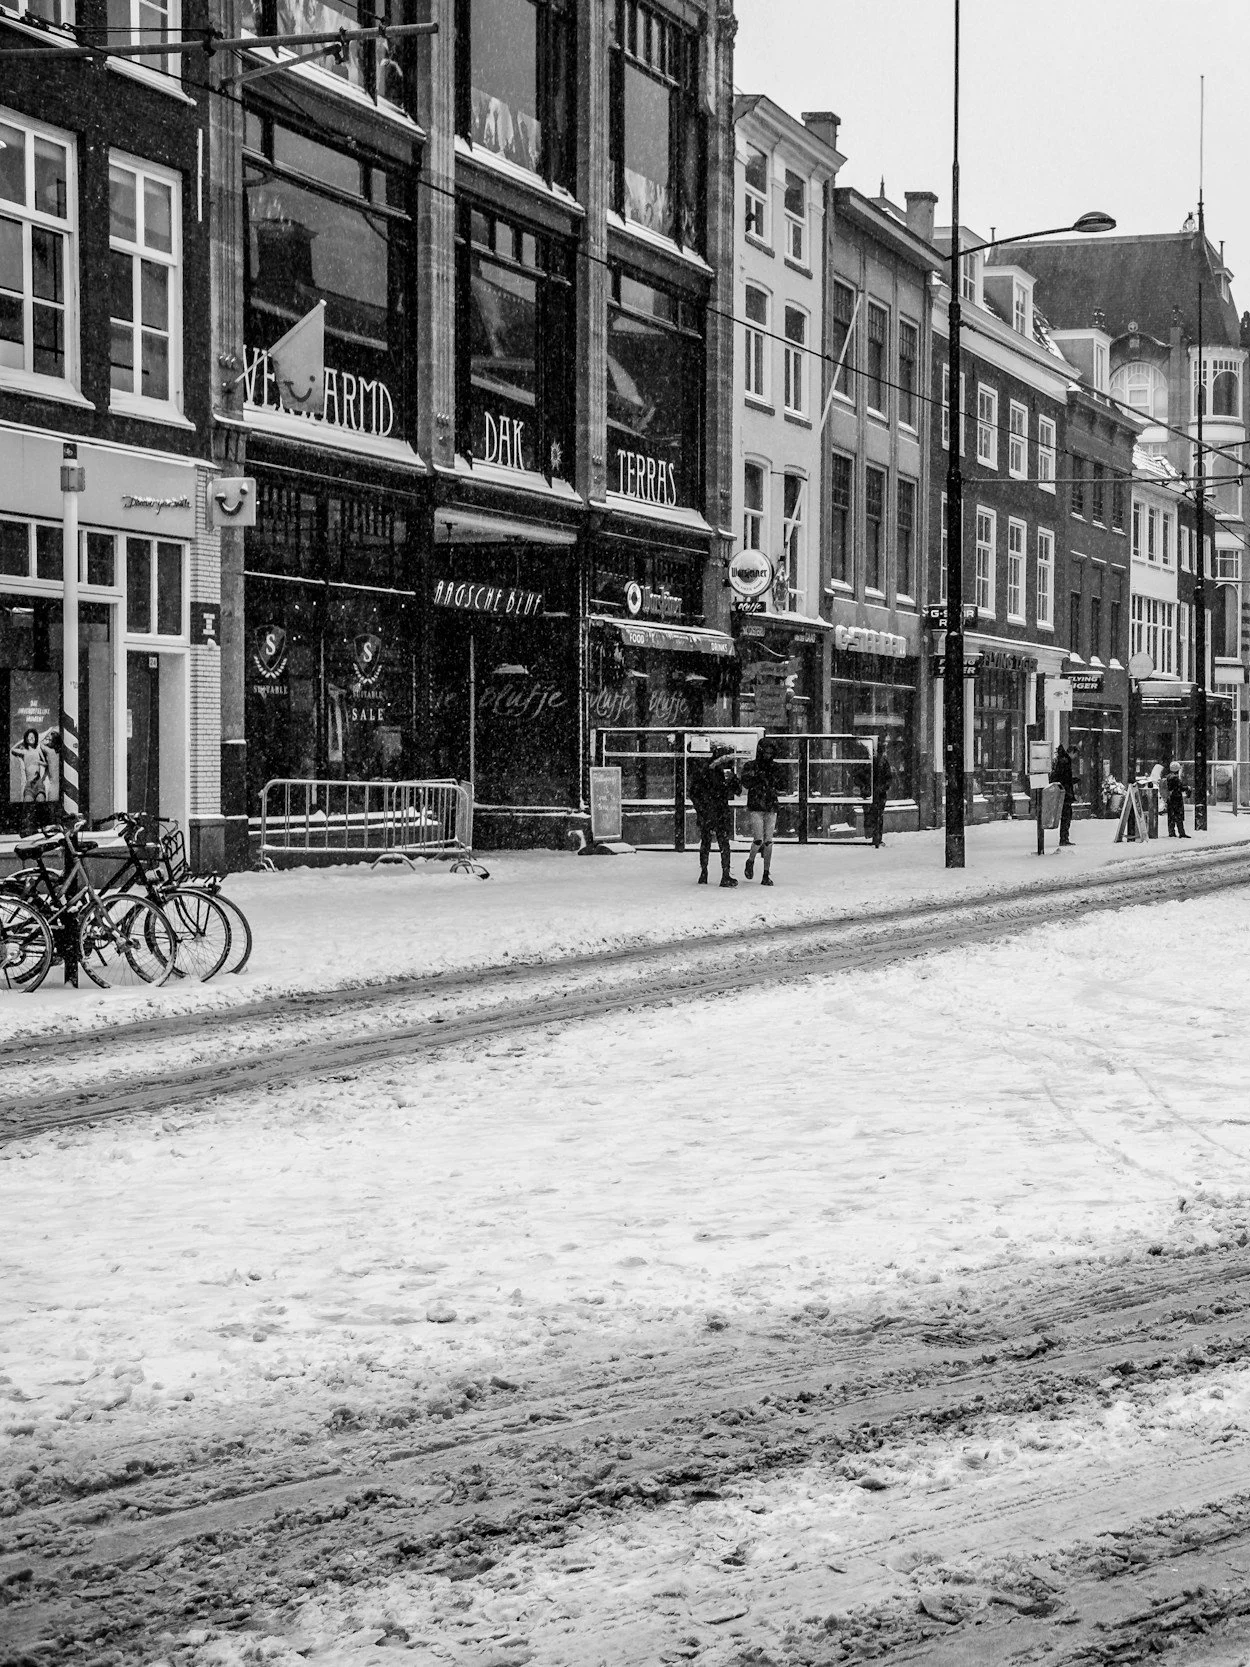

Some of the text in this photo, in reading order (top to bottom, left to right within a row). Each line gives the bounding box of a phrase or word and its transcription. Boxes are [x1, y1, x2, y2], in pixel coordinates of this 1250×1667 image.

[242, 344, 677, 507] VEARMD DAK TERRAS
[629, 632, 645, 645] FOOD
[352, 707, 385, 721] SALE
